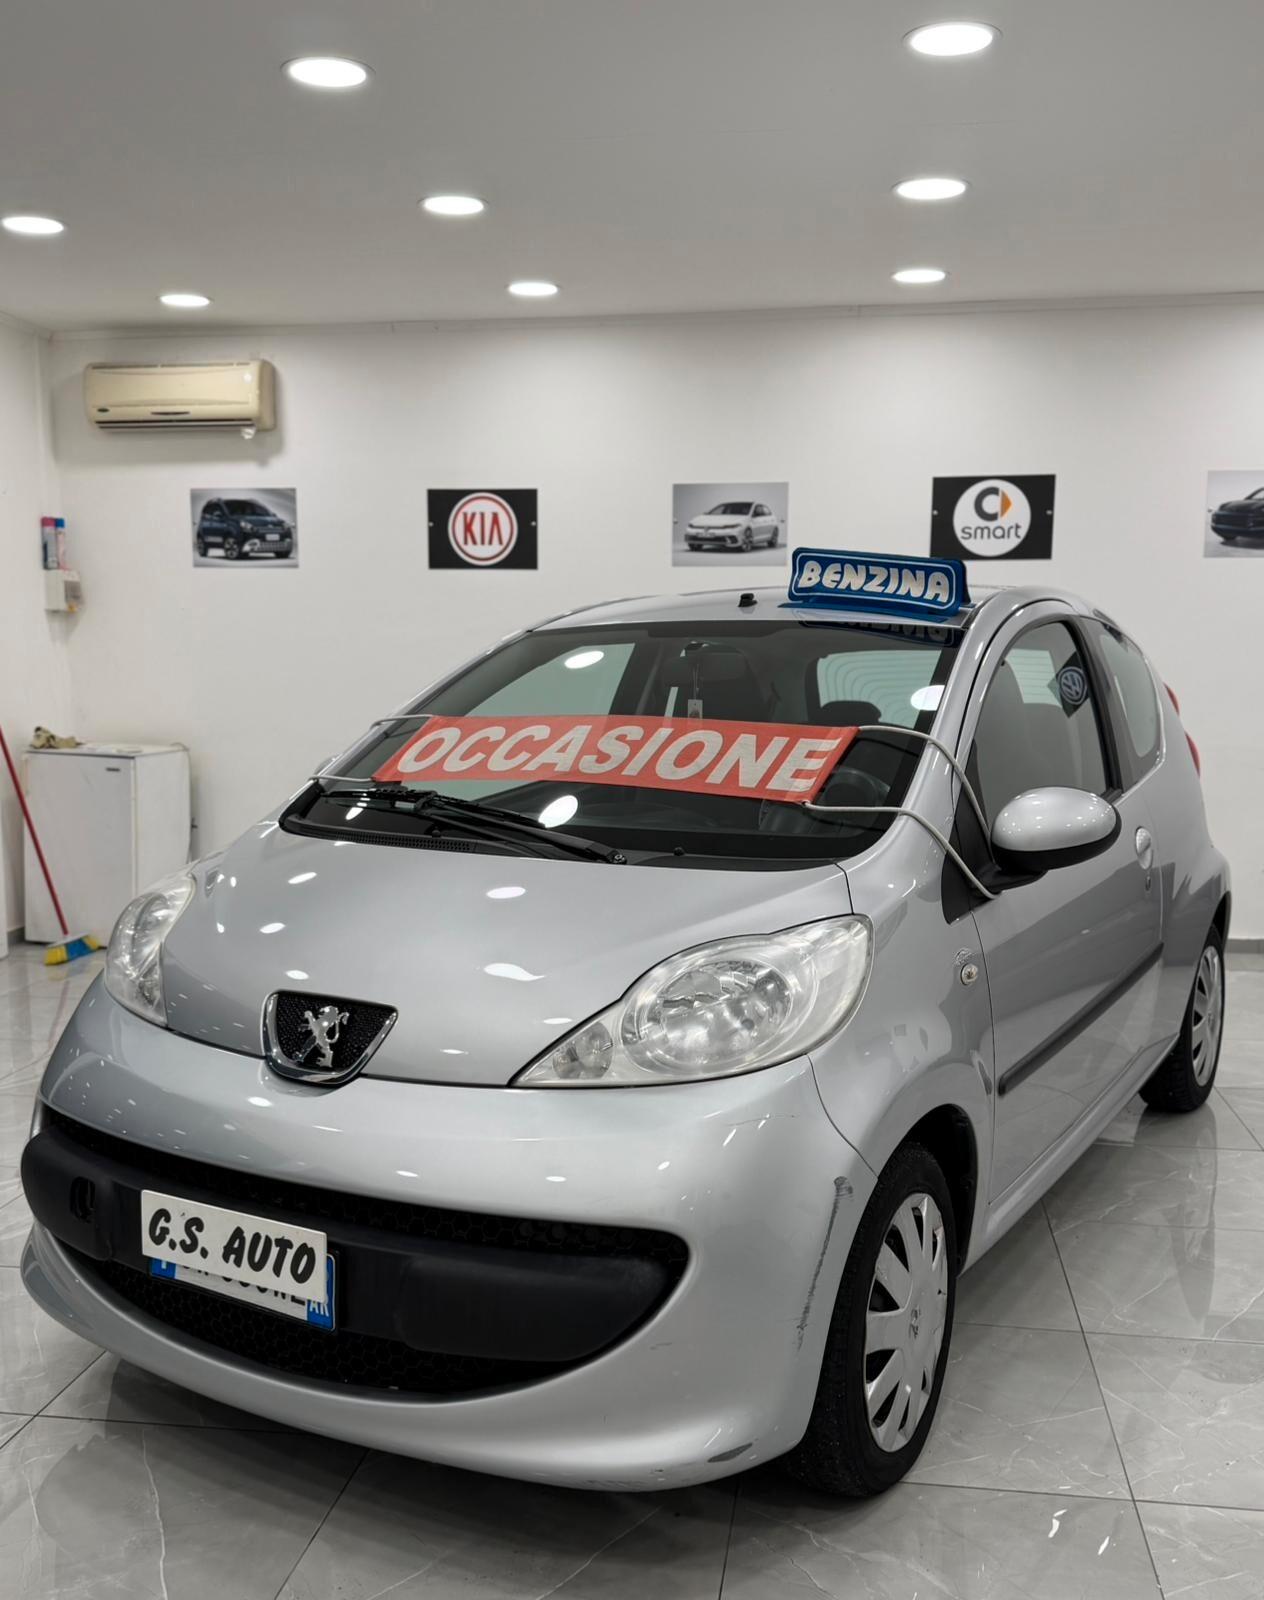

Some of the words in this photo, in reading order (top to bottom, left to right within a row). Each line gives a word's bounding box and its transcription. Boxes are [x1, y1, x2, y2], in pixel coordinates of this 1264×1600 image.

[463, 512, 503, 545] KIA
[961, 523, 1021, 540] smart
[798, 560, 949, 603] BENZINA
[397, 725, 842, 791] OCCASIONE
[148, 1207, 208, 1259] G.S.
[222, 1226, 316, 1284] AUTO
